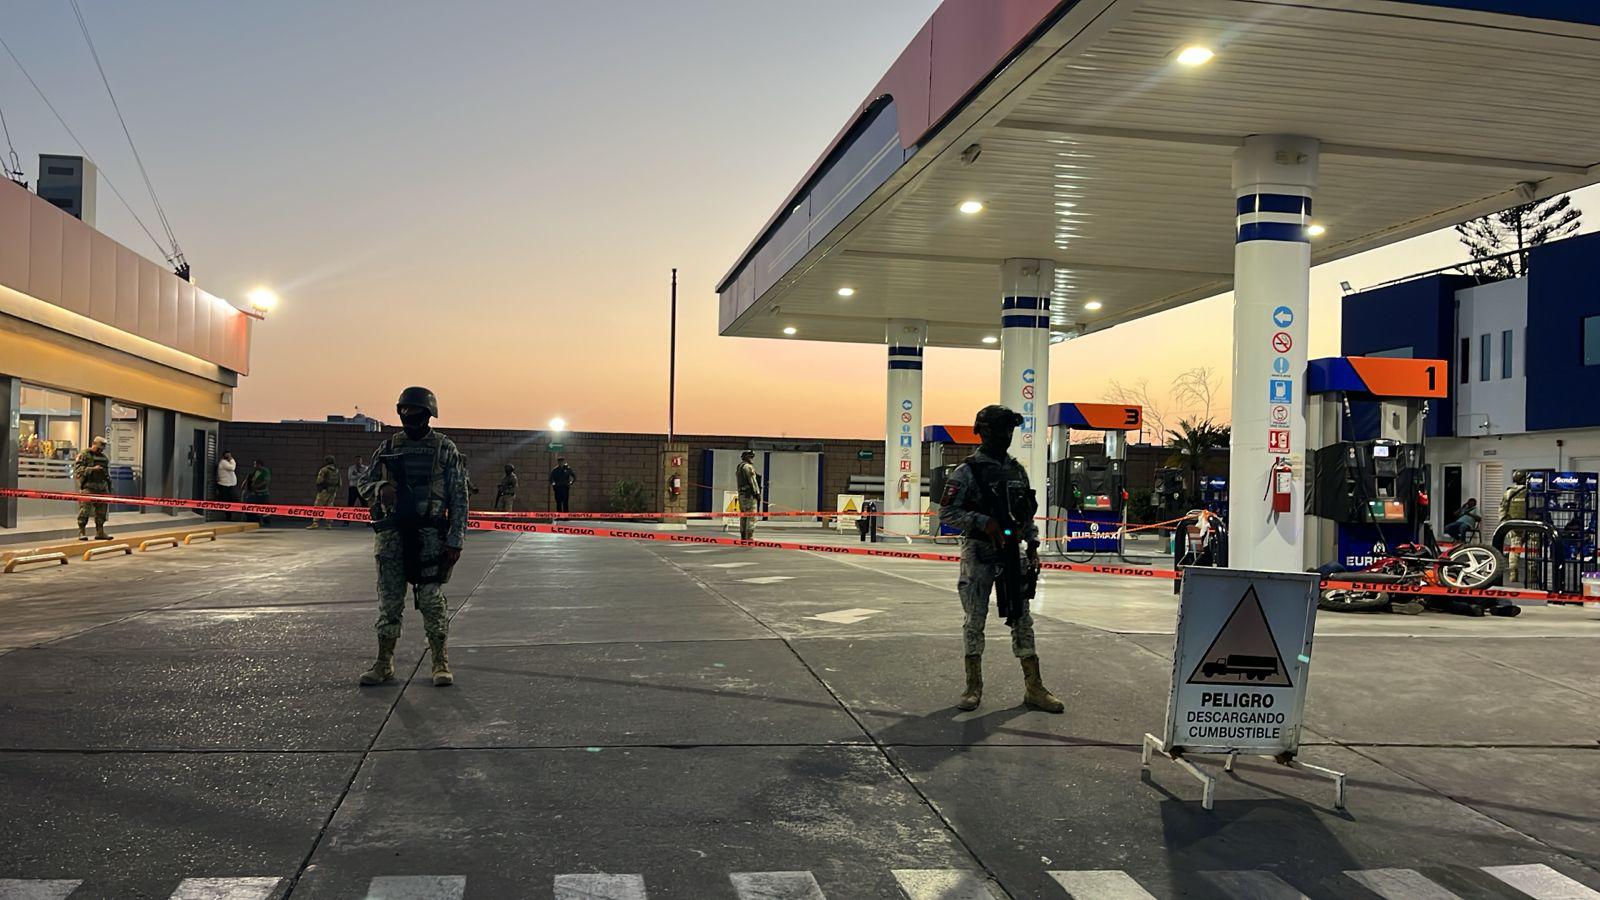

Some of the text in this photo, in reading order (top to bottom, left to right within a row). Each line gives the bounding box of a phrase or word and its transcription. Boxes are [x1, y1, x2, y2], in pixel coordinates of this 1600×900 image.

[1425, 366, 1436, 391] 1
[1124, 408, 1139, 425] 3
[1201, 692, 1274, 708] PELIGRO
[1186, 711, 1285, 724] DESCARGANDO
[1189, 726, 1280, 740] CUMBUSTIBLE
